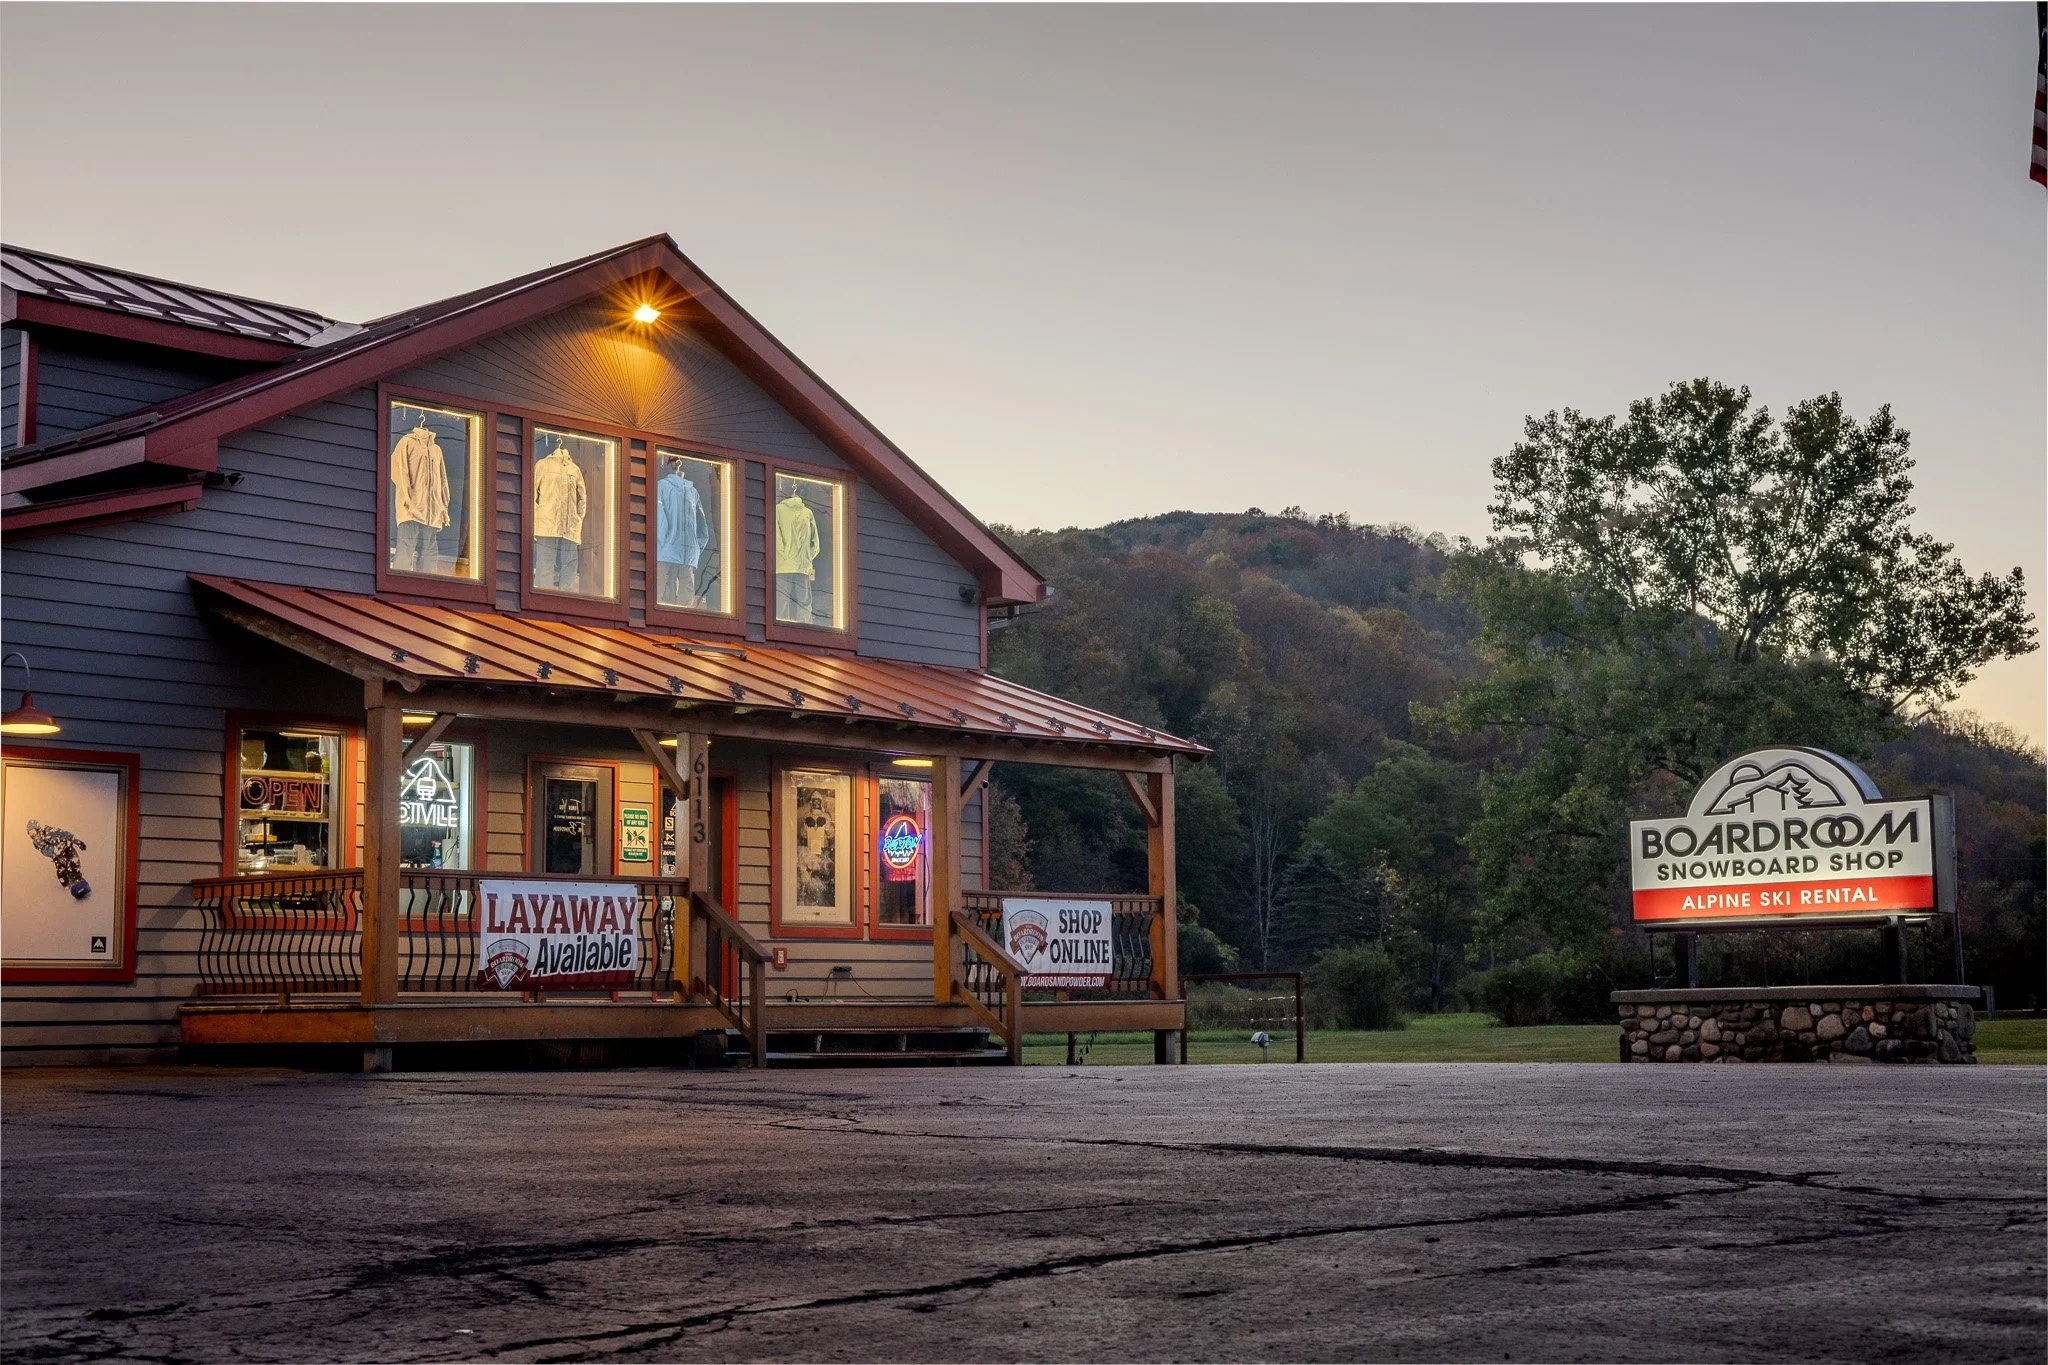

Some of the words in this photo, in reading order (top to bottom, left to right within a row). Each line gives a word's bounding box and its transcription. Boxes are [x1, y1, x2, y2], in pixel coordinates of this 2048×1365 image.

[243, 776, 320, 808] OPEN
[694, 753, 706, 843] 6113
[1641, 810, 1920, 860] BOARDROOM
[1657, 855, 1819, 881] SNOWBOARD
[1829, 850, 1904, 873] SHOP
[487, 893, 637, 935] LAYAWAY
[1682, 890, 1751, 911] ALPINE
[1760, 890, 1791, 906] SKI
[1801, 886, 1878, 905] RENTAL
[1059, 909, 1102, 934] SHOP
[532, 932, 632, 975] Available
[1050, 938, 1110, 964] ONLINE
